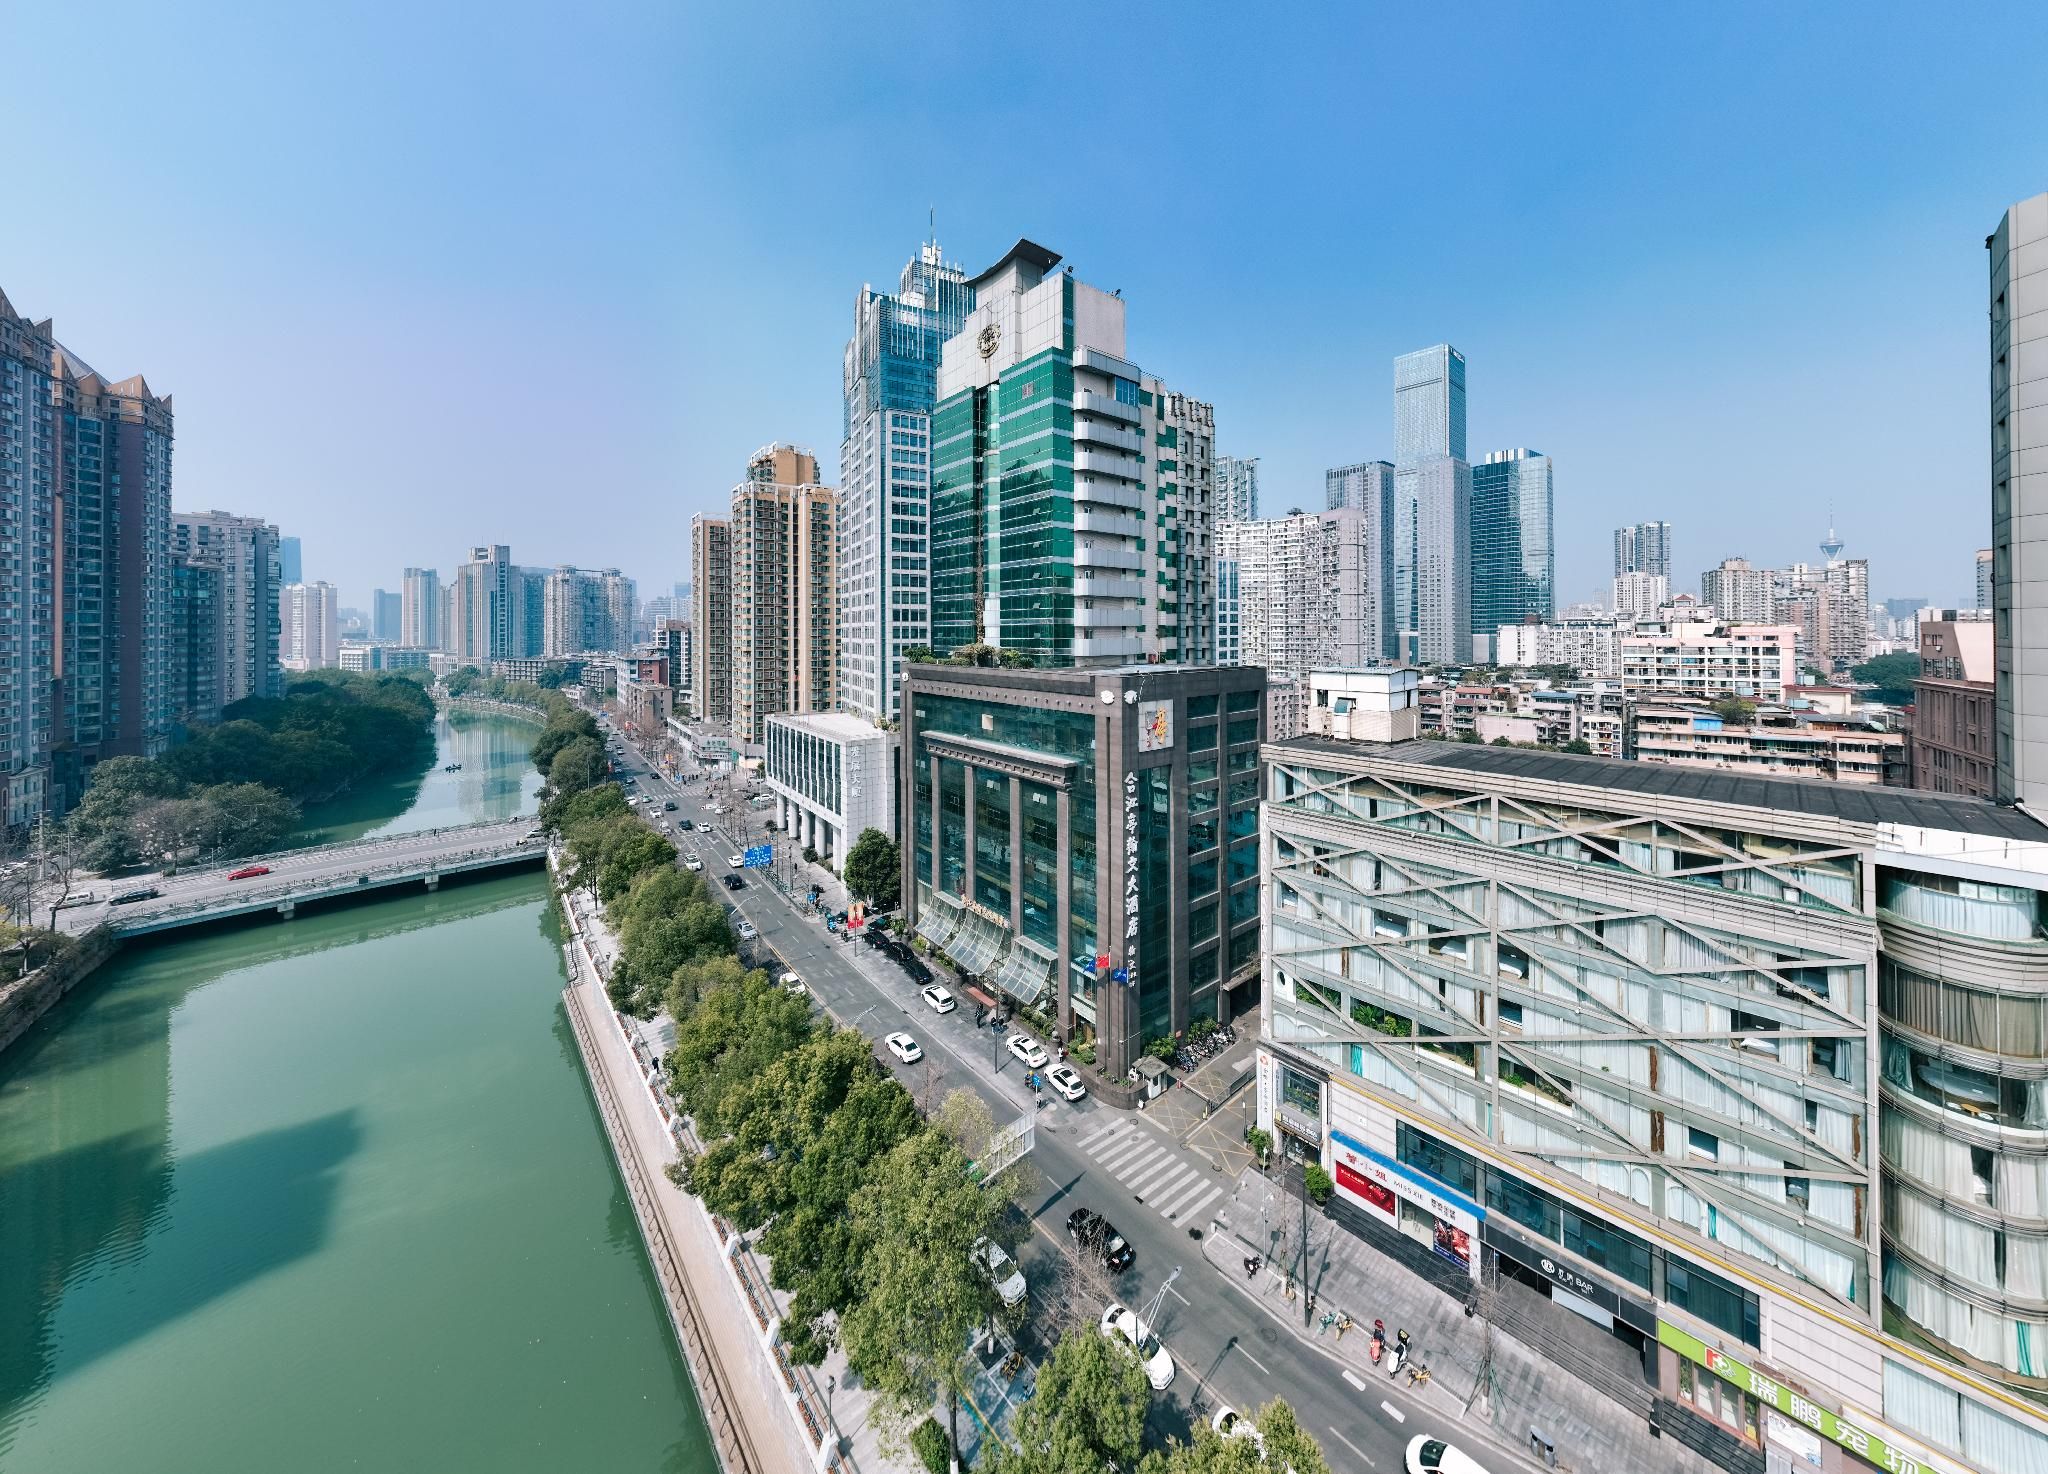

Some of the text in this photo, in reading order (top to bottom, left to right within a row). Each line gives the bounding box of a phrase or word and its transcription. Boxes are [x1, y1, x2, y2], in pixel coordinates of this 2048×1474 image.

[1124, 771, 1139, 939] 合江亭翰文大酒店
[1575, 1277, 1594, 1294] BAR
[1749, 1370, 1919, 1474] 瑞鹏宠物
